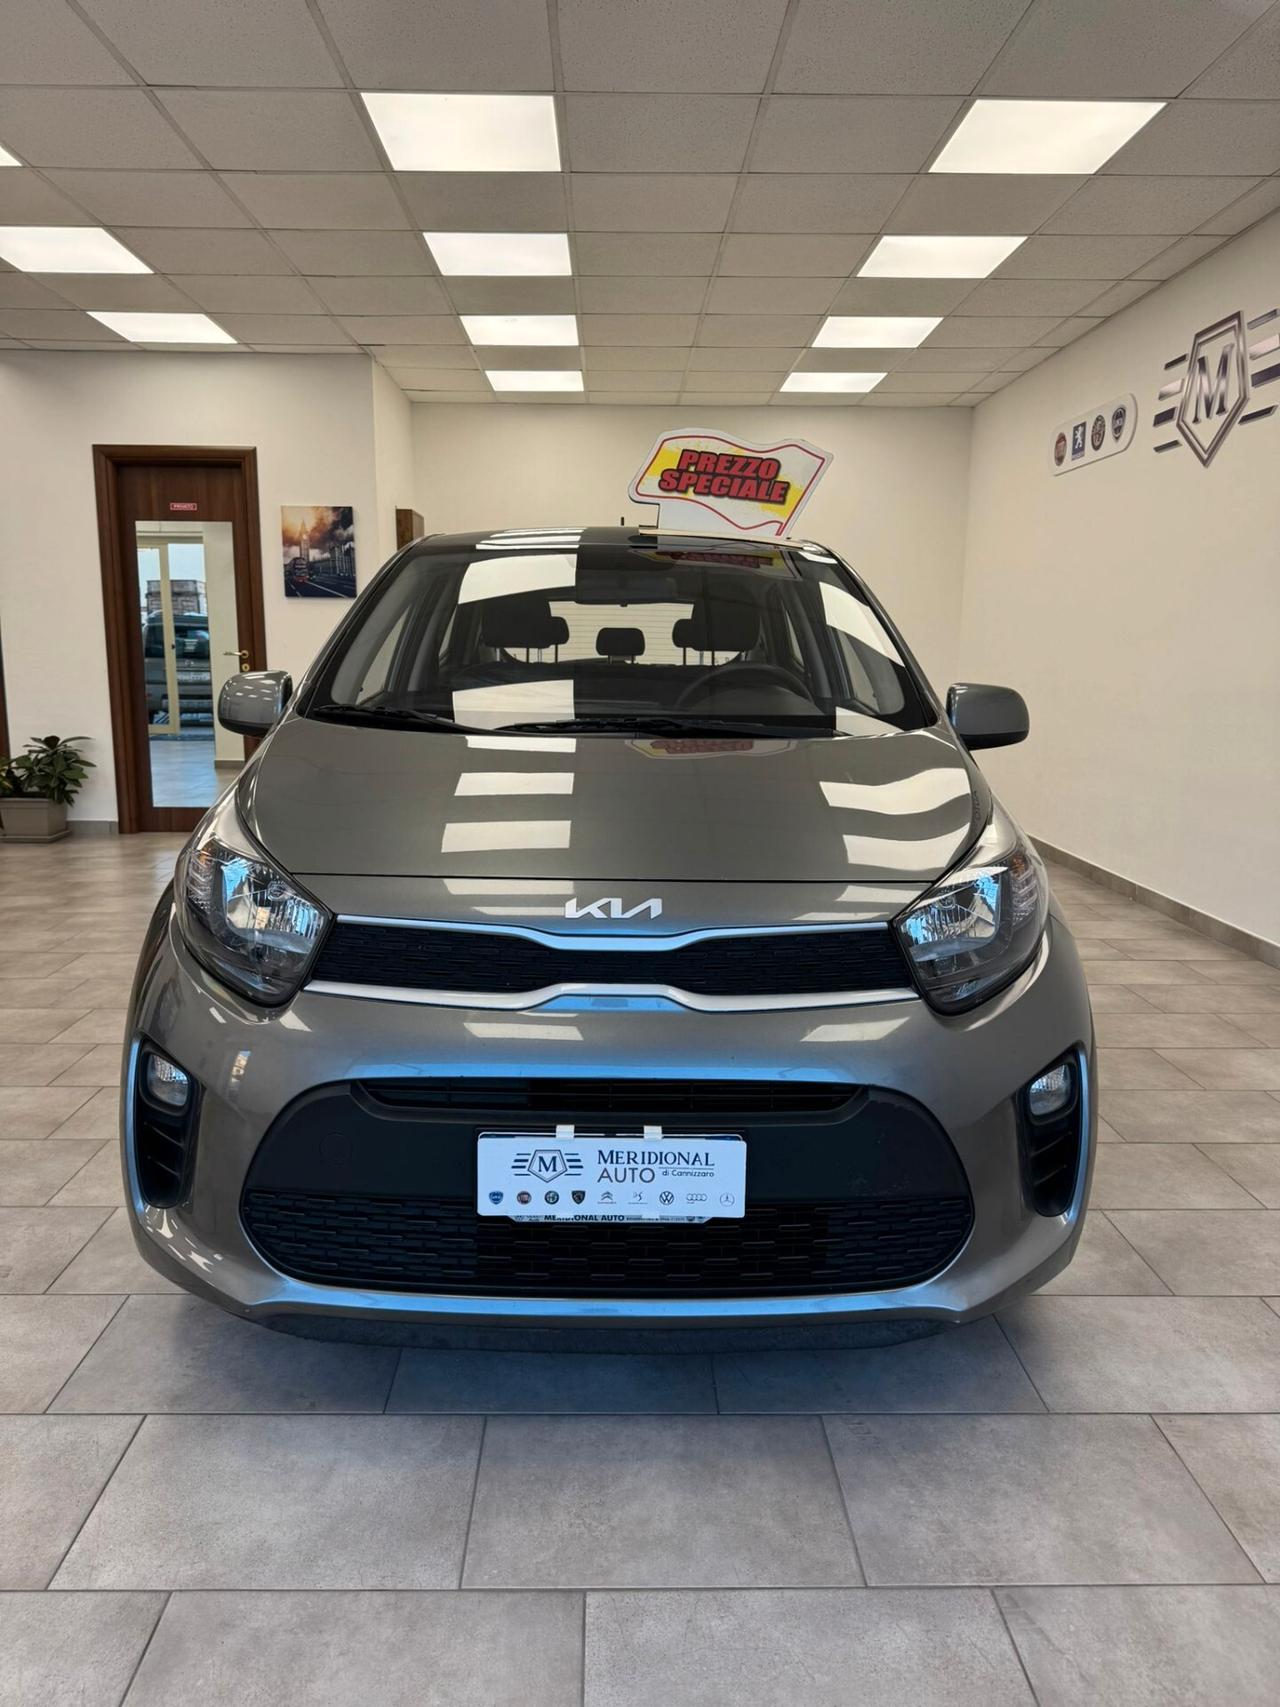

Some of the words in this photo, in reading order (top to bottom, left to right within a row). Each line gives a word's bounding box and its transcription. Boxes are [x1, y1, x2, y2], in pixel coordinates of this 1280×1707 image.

[676, 449, 782, 481] PREZZO
[658, 468, 790, 504] SPECIALE
[564, 897, 662, 919] KIA
[538, 1155, 558, 1173] M
[597, 1149, 715, 1167] MERIDIONAL
[597, 1167, 656, 1184] AUTO
[662, 1169, 669, 1177] di
[671, 1169, 715, 1178] Cannizzaro
